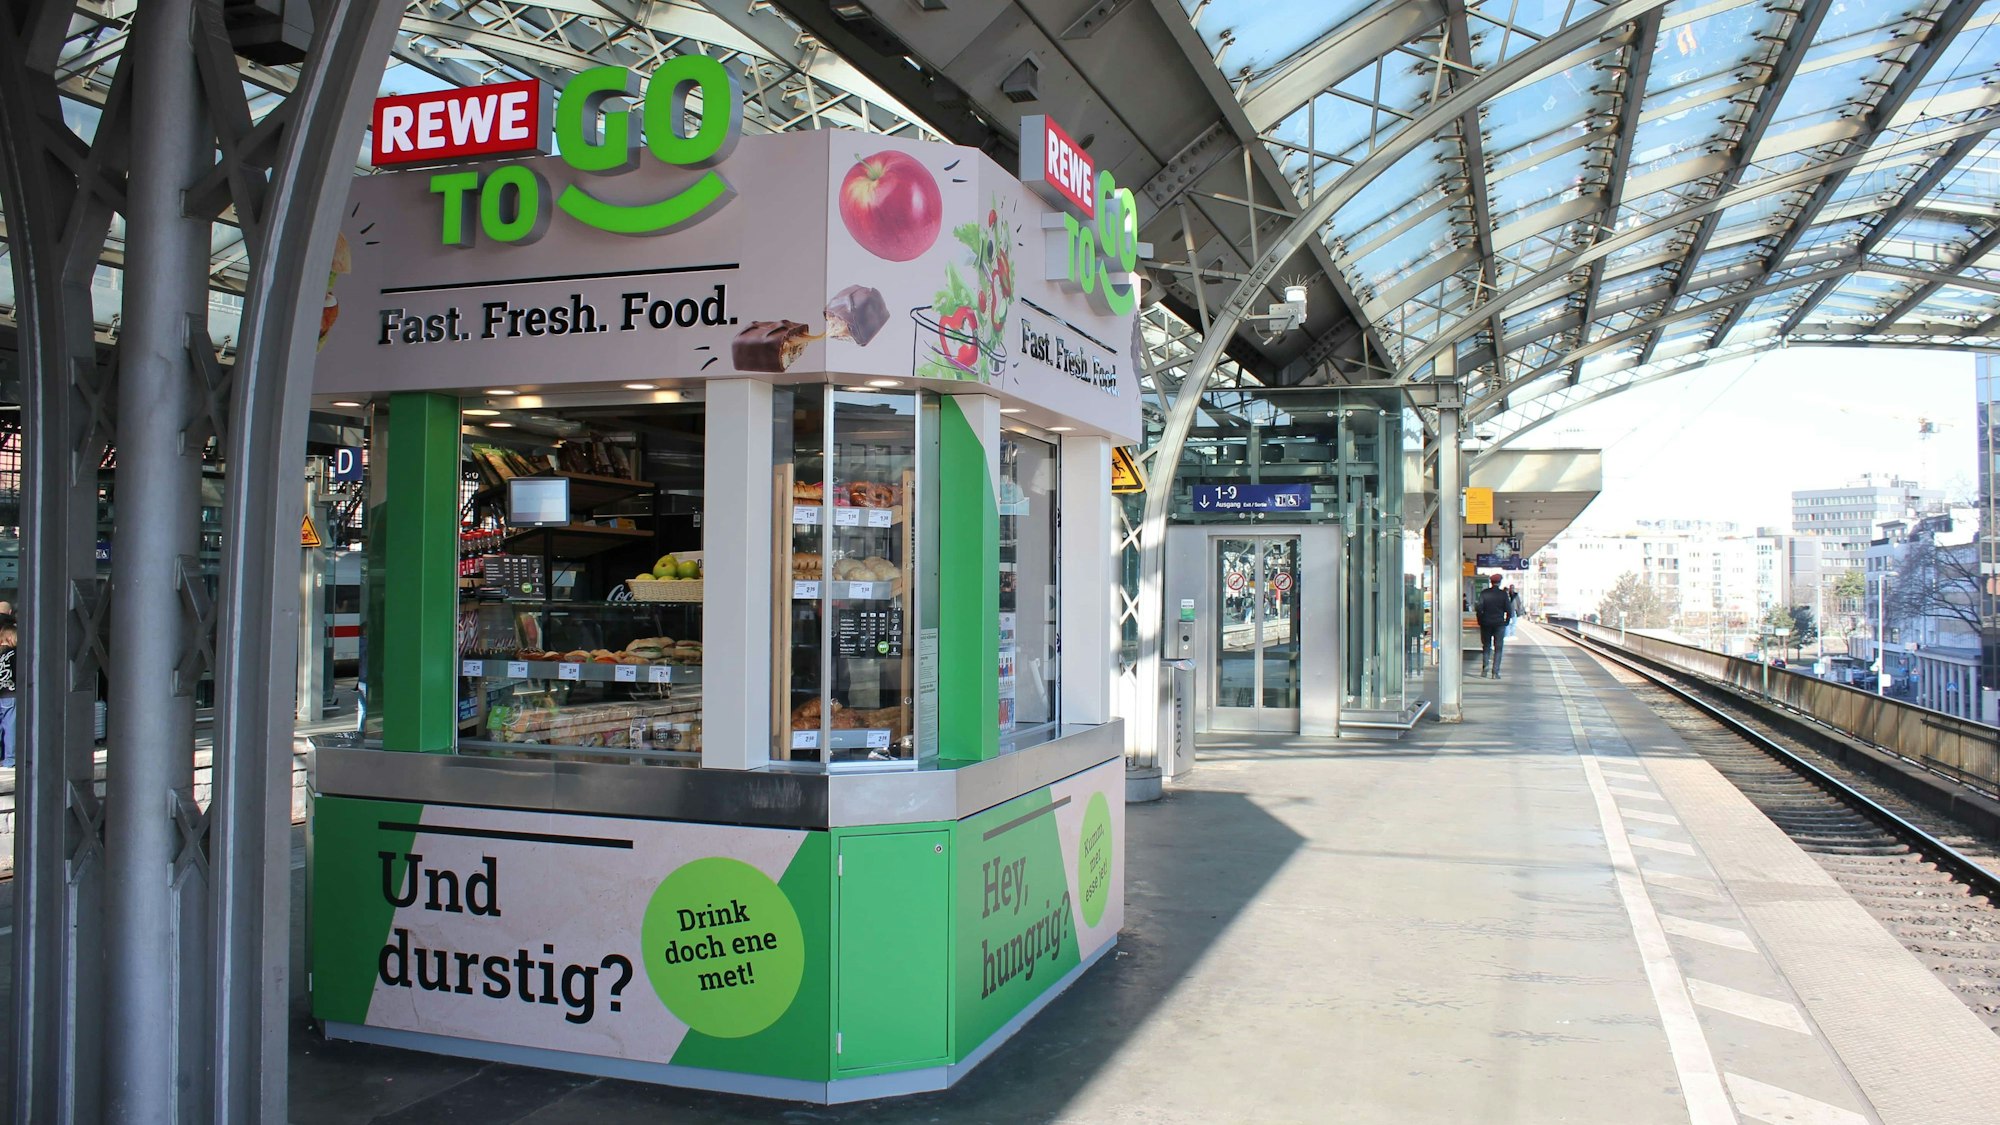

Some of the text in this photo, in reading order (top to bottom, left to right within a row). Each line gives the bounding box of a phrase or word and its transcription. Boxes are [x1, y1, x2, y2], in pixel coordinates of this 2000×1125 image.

[381, 90, 530, 154] REWE
[556, 55, 732, 170] GO
[1048, 128, 1092, 208] REWE
[429, 165, 539, 246] TO
[1098, 169, 1138, 273] GO
[1064, 211, 1096, 295] TO
[378, 284, 738, 346] Fast. Fresh. Food.
[1020, 317, 1053, 367] Fast.
[1055, 334, 1091, 384] Fresh.
[337, 448, 354, 475] D
[1215, 486, 1237, 500] 1-9
[1520, 558, 1529, 569] C
[377, 850, 502, 918] Und
[677, 899, 750, 932] Drink
[982, 856, 1029, 919] Hey,
[1086, 875, 1098, 903] esse
[377, 927, 634, 1024] durstig?
[664, 932, 778, 964] doch ene
[699, 961, 755, 991] met!
[981, 890, 1071, 1001] hungrig?
